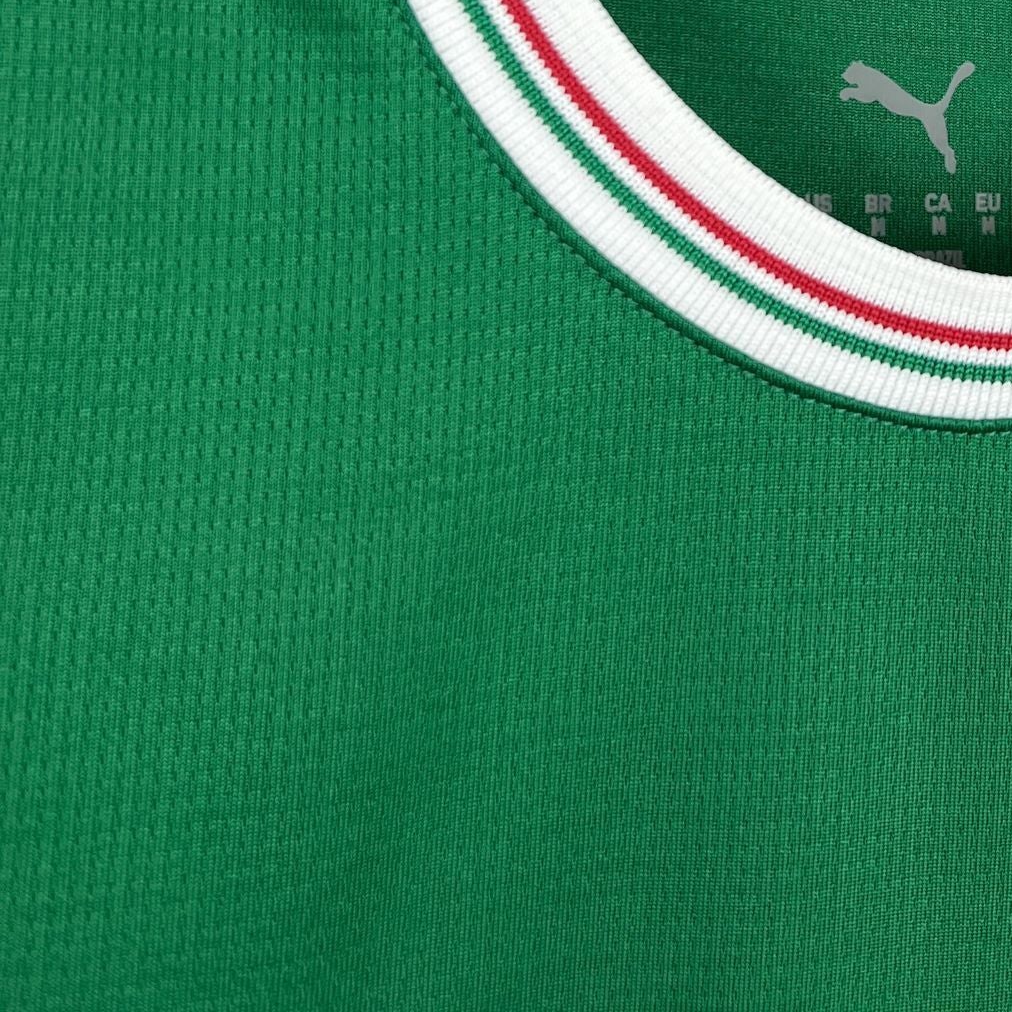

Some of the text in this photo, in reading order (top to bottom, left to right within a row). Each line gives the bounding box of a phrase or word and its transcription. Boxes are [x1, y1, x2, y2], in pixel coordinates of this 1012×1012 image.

[864, 194, 892, 214] BR
[924, 193, 952, 213] CA
[975, 193, 1001, 213] EU
[931, 216, 947, 236] M
[914, 250, 966, 268] AZIL
